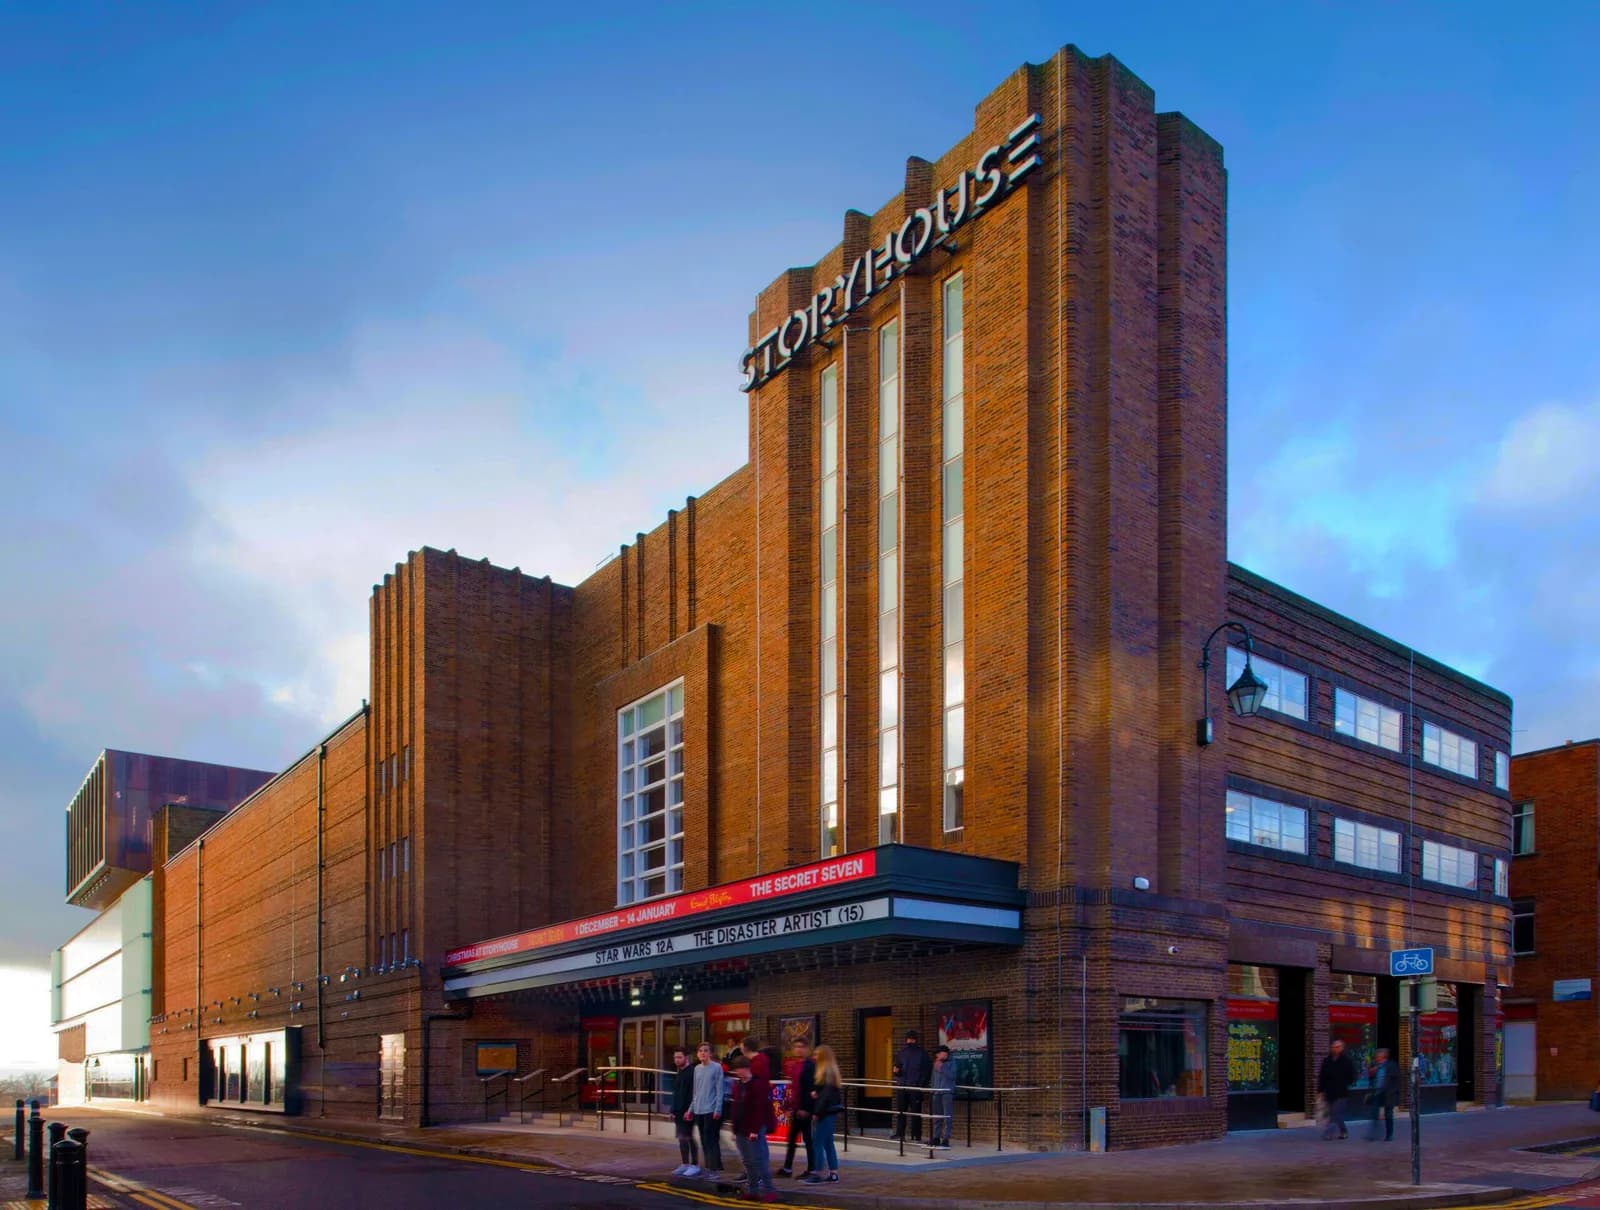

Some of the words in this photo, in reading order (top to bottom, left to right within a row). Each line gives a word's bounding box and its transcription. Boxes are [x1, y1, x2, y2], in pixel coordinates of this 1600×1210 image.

[738, 112, 1043, 393] STORYHOUSE
[750, 880, 772, 897] THE
[774, 869, 819, 892] SECRET
[821, 859, 863, 881] SEVEN
[579, 915, 619, 934] DECEMBER
[626, 913, 636, 925] 14
[636, 902, 677, 922] JANUARY
[693, 930, 714, 947] THE
[717, 919, 777, 944] DISASTER
[783, 909, 832, 933] ARTIST
[838, 905, 864, 923] (15)
[447, 948, 476, 963] CHRISTMAS
[482, 939, 520, 956] STORYHOUSE
[595, 948, 619, 964] STAR
[622, 942, 652, 959] WARS
[656, 938, 674, 953] 12A
